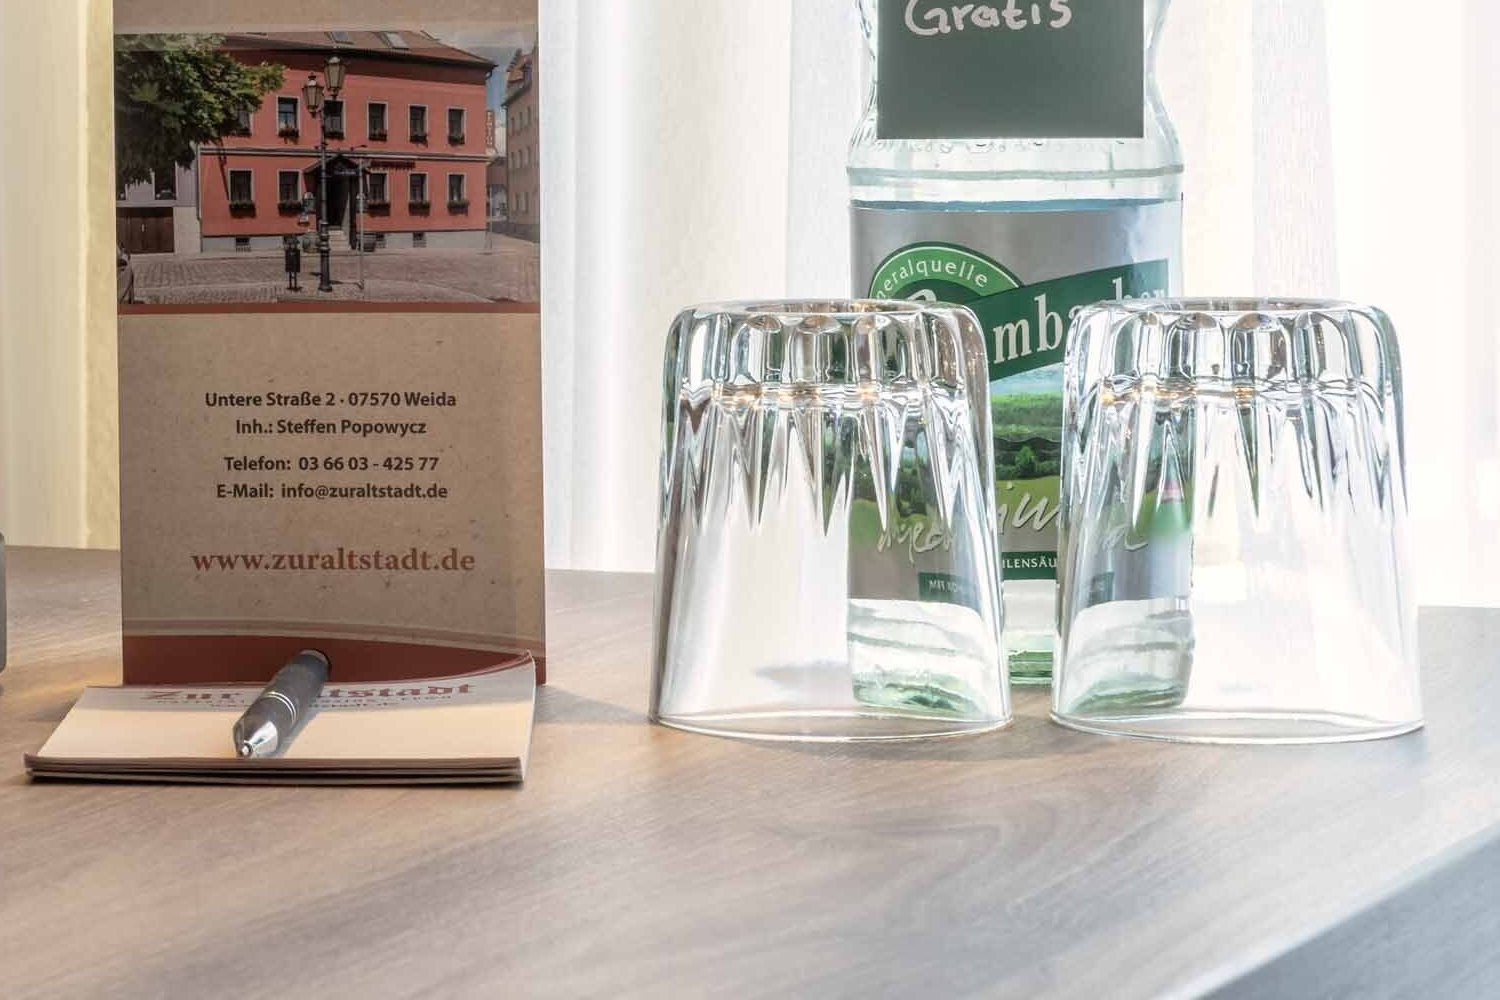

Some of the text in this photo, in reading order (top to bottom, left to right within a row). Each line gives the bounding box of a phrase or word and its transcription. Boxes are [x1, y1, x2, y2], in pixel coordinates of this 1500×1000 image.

[875, 257, 989, 301] neralquelle
[205, 393, 262, 407] Untere
[266, 392, 321, 407] Straße
[325, 393, 336, 406] 2
[348, 392, 400, 407] 07570
[404, 392, 457, 407] Weida
[235, 419, 427, 438] Inh.: Steffen Popowycz
[224, 456, 292, 471] Telefon:
[298, 457, 319, 471] 03
[323, 457, 344, 471] 66
[348, 457, 368, 471] 03
[382, 457, 414, 471] 425
[418, 457, 439, 471] 77
[216, 483, 448, 500] E-Mail: info@zuraltstadt.de
[191, 547, 476, 571] www.zuraltstadt.de
